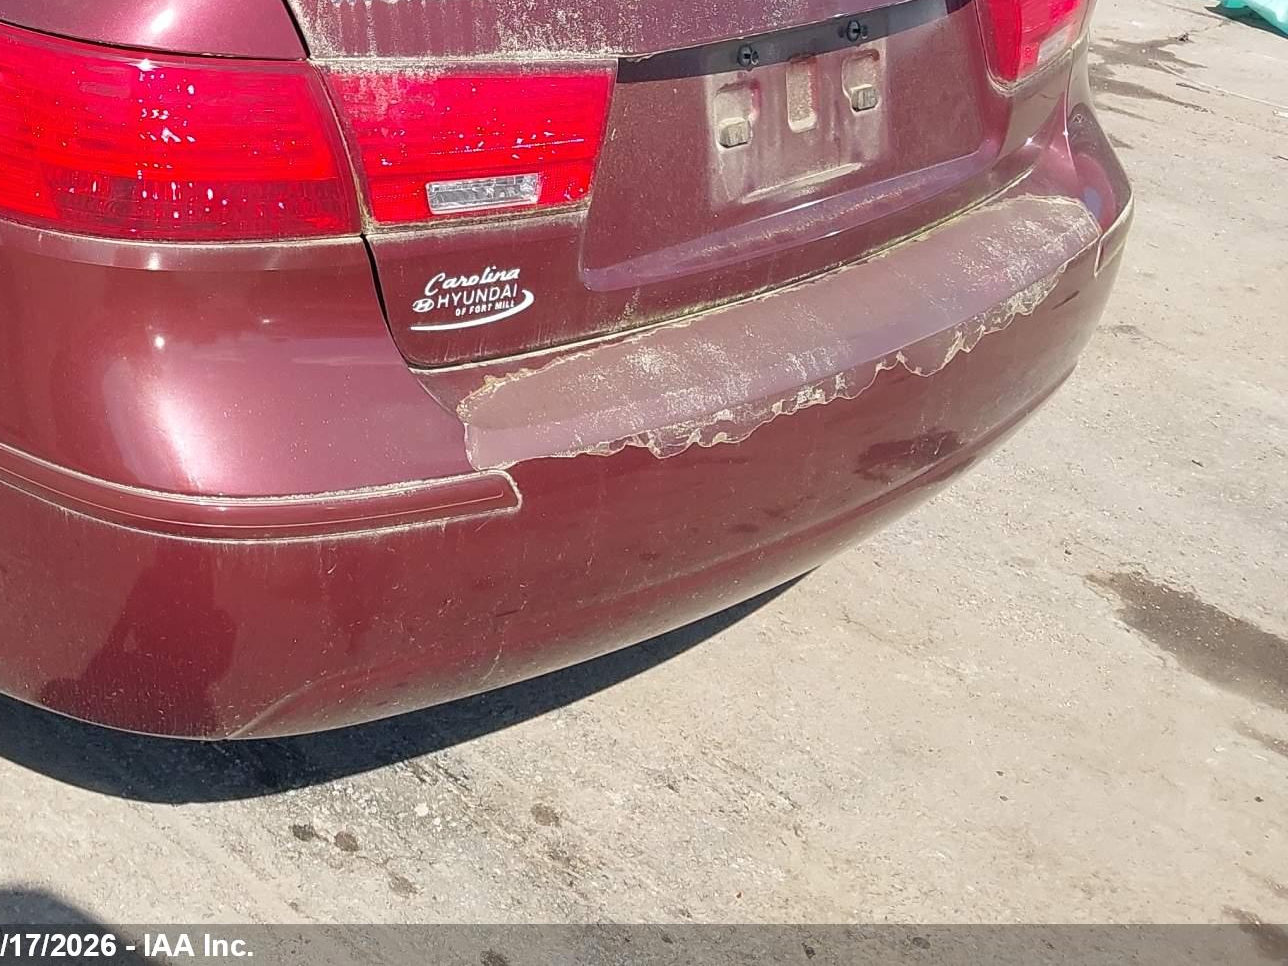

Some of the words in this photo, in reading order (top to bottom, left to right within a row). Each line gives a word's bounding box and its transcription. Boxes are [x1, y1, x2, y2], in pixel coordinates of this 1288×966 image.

[424, 265, 520, 296] Carolina
[437, 283, 518, 309] HYUNDAI
[455, 307, 466, 316] OF
[469, 303, 492, 315] FORT
[494, 300, 515, 310] MILL
